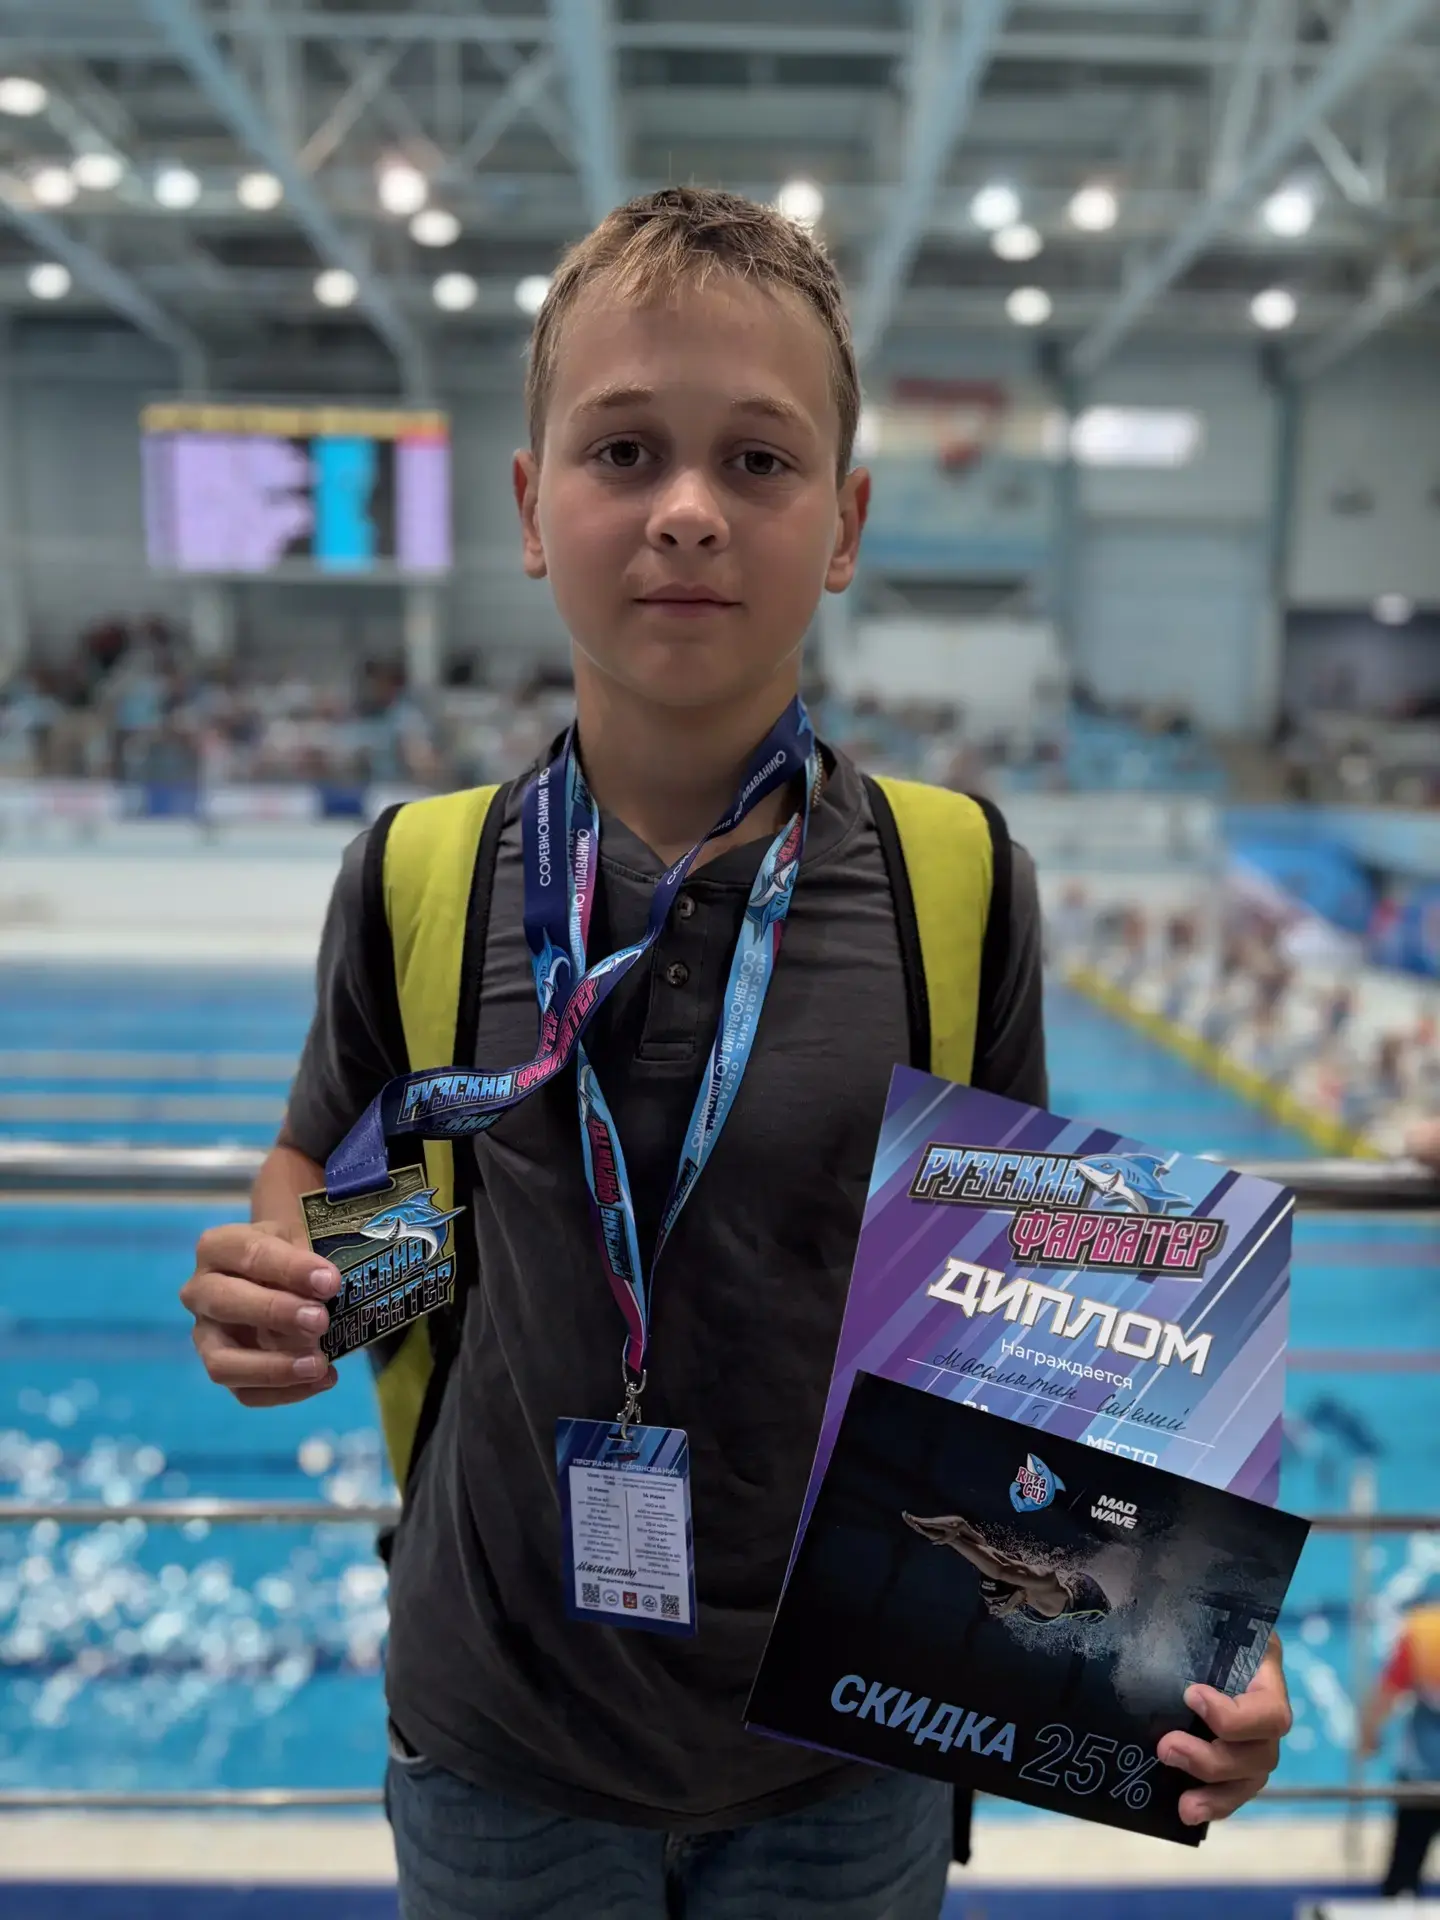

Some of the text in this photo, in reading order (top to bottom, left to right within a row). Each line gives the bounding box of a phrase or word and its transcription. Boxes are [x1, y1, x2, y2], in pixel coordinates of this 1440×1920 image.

[742, 750, 787, 802] ПЛАВАНИЮ
[537, 767, 551, 887] СОРЕВНОВАНИЯ ПО
[574, 828, 591, 890] ПЛАВАНИЮ
[573, 893, 586, 912] ПО
[720, 950, 757, 1053] СОРЕВНОВАНИЯ
[735, 953, 768, 1052] МОСКОВСКИЕ
[715, 1054, 731, 1077] ПО
[402, 1074, 513, 1119] РУЗСКИЙ
[915, 1147, 1086, 1205] РУЗСКИЙ
[1013, 1208, 1220, 1268] ФАРВАТЕР
[335, 1238, 424, 1313] УЗСКИЙ
[322, 1261, 452, 1357] ФАРВАТЕР
[927, 1258, 1214, 1376] ДИПЛОМ
[1001, 1338, 1134, 1390] Награждается
[1015, 1466, 1047, 1489] Ruza
[1086, 1435, 1159, 1467] МЕСТО
[1022, 1482, 1047, 1504] Cup
[1090, 1505, 1138, 1529] WAVE
[1097, 1495, 1138, 1515] MAD
[830, 1674, 1160, 1810] СКИДКА 25%
